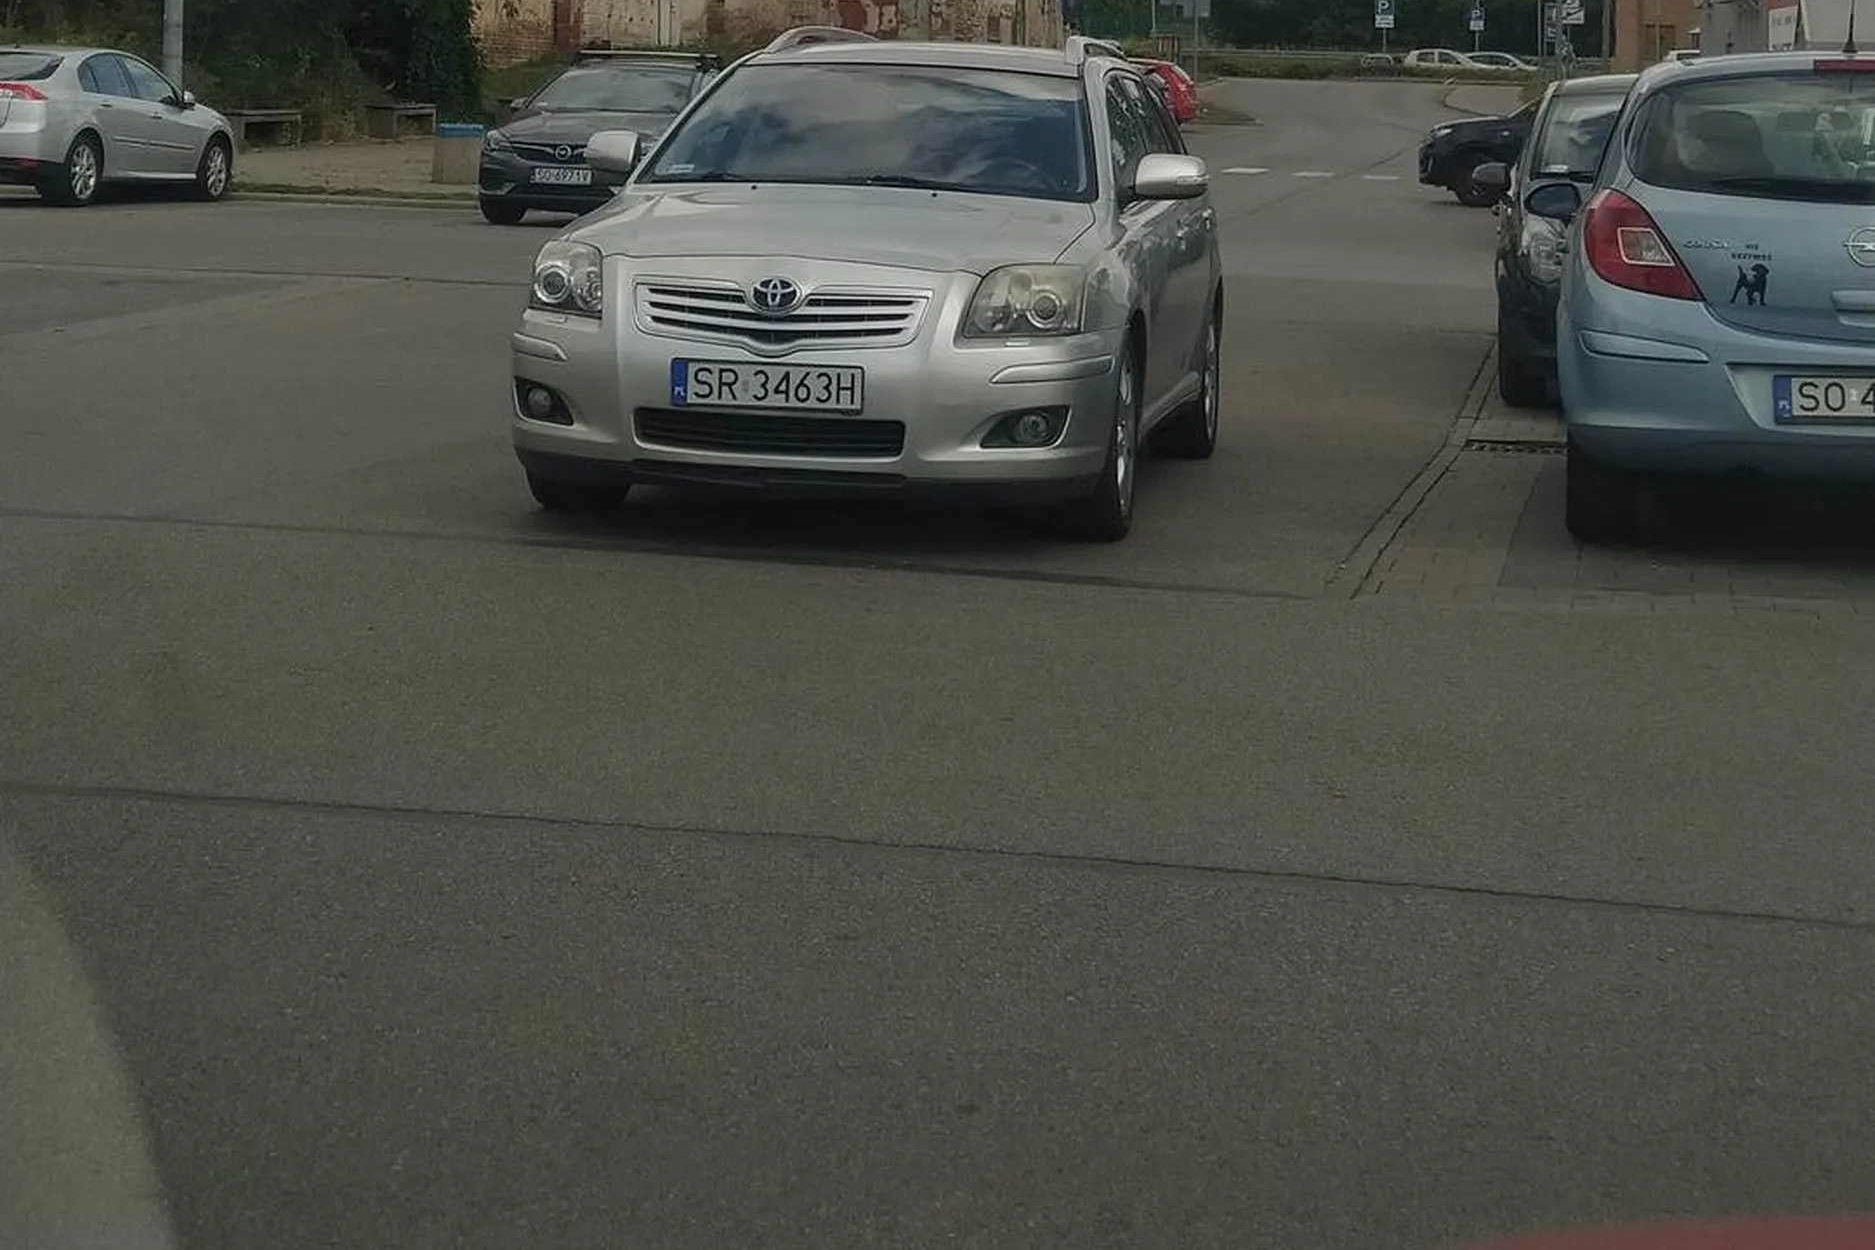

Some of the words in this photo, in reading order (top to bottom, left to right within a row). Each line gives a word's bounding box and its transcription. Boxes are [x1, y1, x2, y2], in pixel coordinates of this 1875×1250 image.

[1378, 0, 1390, 15] P
[693, 366, 738, 401] SR
[752, 369, 855, 405] 3463H
[1798, 381, 1846, 412] SO
